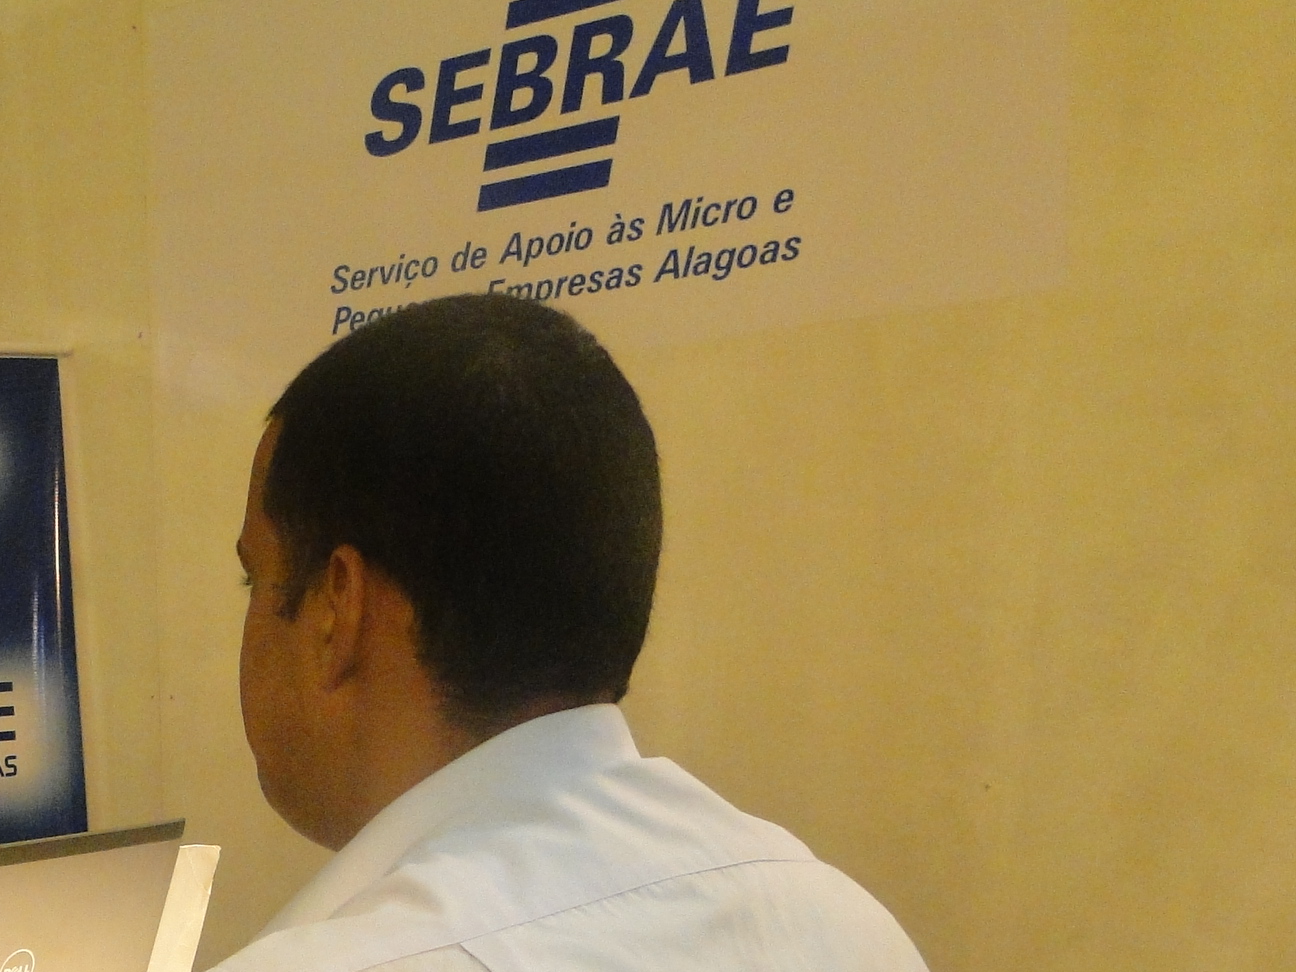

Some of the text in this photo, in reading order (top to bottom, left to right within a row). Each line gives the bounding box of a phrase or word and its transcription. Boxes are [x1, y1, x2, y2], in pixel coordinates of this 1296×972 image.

[364, 0, 795, 158] SEBRAE
[330, 187, 795, 294] Serviço de Apoio às Micro e
[655, 233, 802, 284] Alagoas
